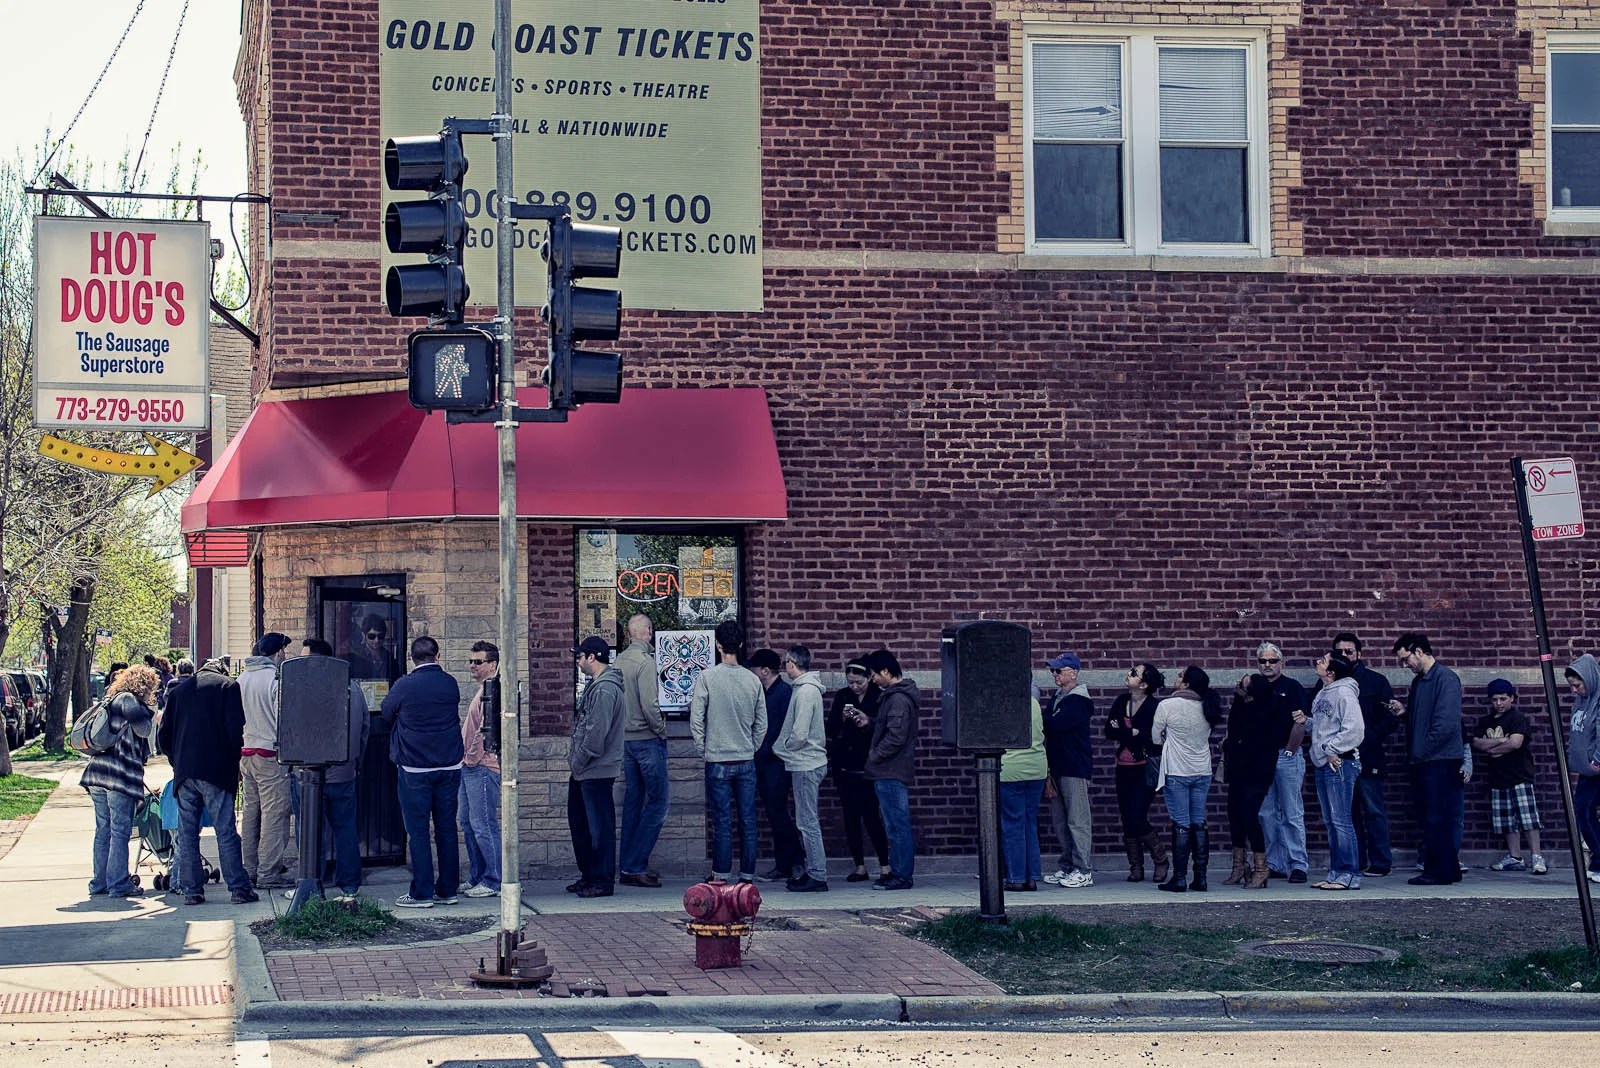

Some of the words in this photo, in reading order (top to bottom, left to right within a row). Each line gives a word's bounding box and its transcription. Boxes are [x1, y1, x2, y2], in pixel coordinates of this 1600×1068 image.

[386, 19, 475, 51] GOLD
[491, 23, 602, 55] OAST
[617, 27, 754, 62] TICKETS
[432, 75, 525, 94] CONCES
[544, 79, 612, 96] SPORTS
[633, 82, 710, 99] THEATRE
[538, 119, 549, 134] &
[557, 120, 669, 138] NATIONWIDE
[90, 231, 157, 276] HOT
[60, 278, 185, 326] DOUG'S
[75, 331, 103, 351] The
[106, 332, 170, 357] Sausage
[80, 353, 164, 377] Superstore
[55, 397, 184, 423] 773-279-9550
[1535, 526, 1553, 538] TOW
[1557, 524, 1580, 536] ZONE
[617, 570, 681, 596] OPEN
